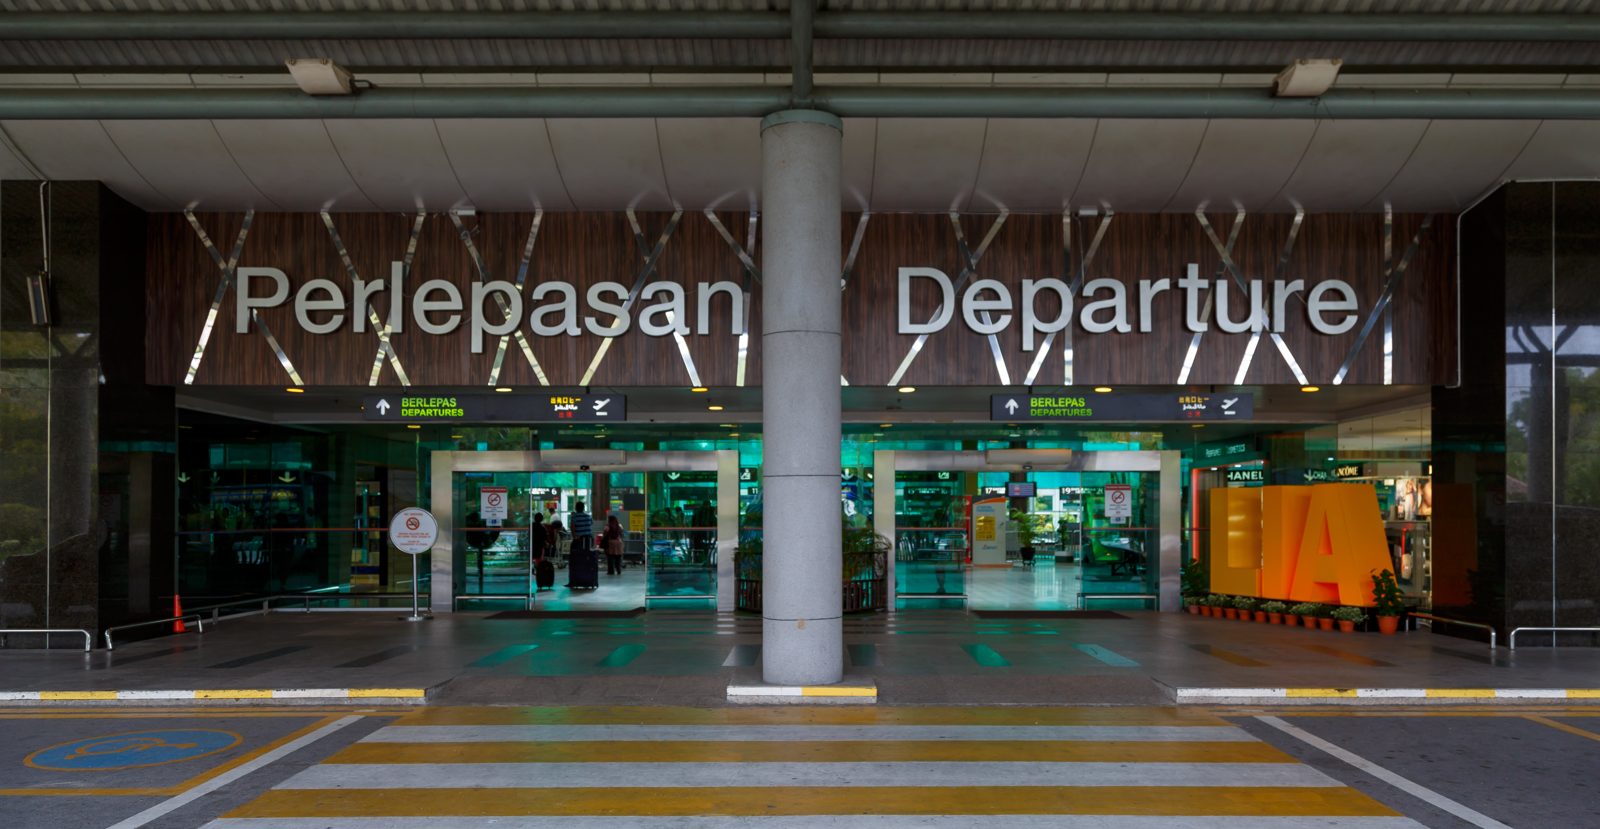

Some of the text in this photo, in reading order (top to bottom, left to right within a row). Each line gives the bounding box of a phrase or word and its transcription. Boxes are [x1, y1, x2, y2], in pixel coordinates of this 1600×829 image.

[235, 260, 745, 354] Perlepasan
[897, 262, 1360, 352] Departure
[401, 397, 457, 408] BERLEPAS
[1030, 397, 1086, 408] BERLEPAS
[401, 408, 464, 417] DEPARTURES
[1030, 408, 1093, 417] DEPARTURES
